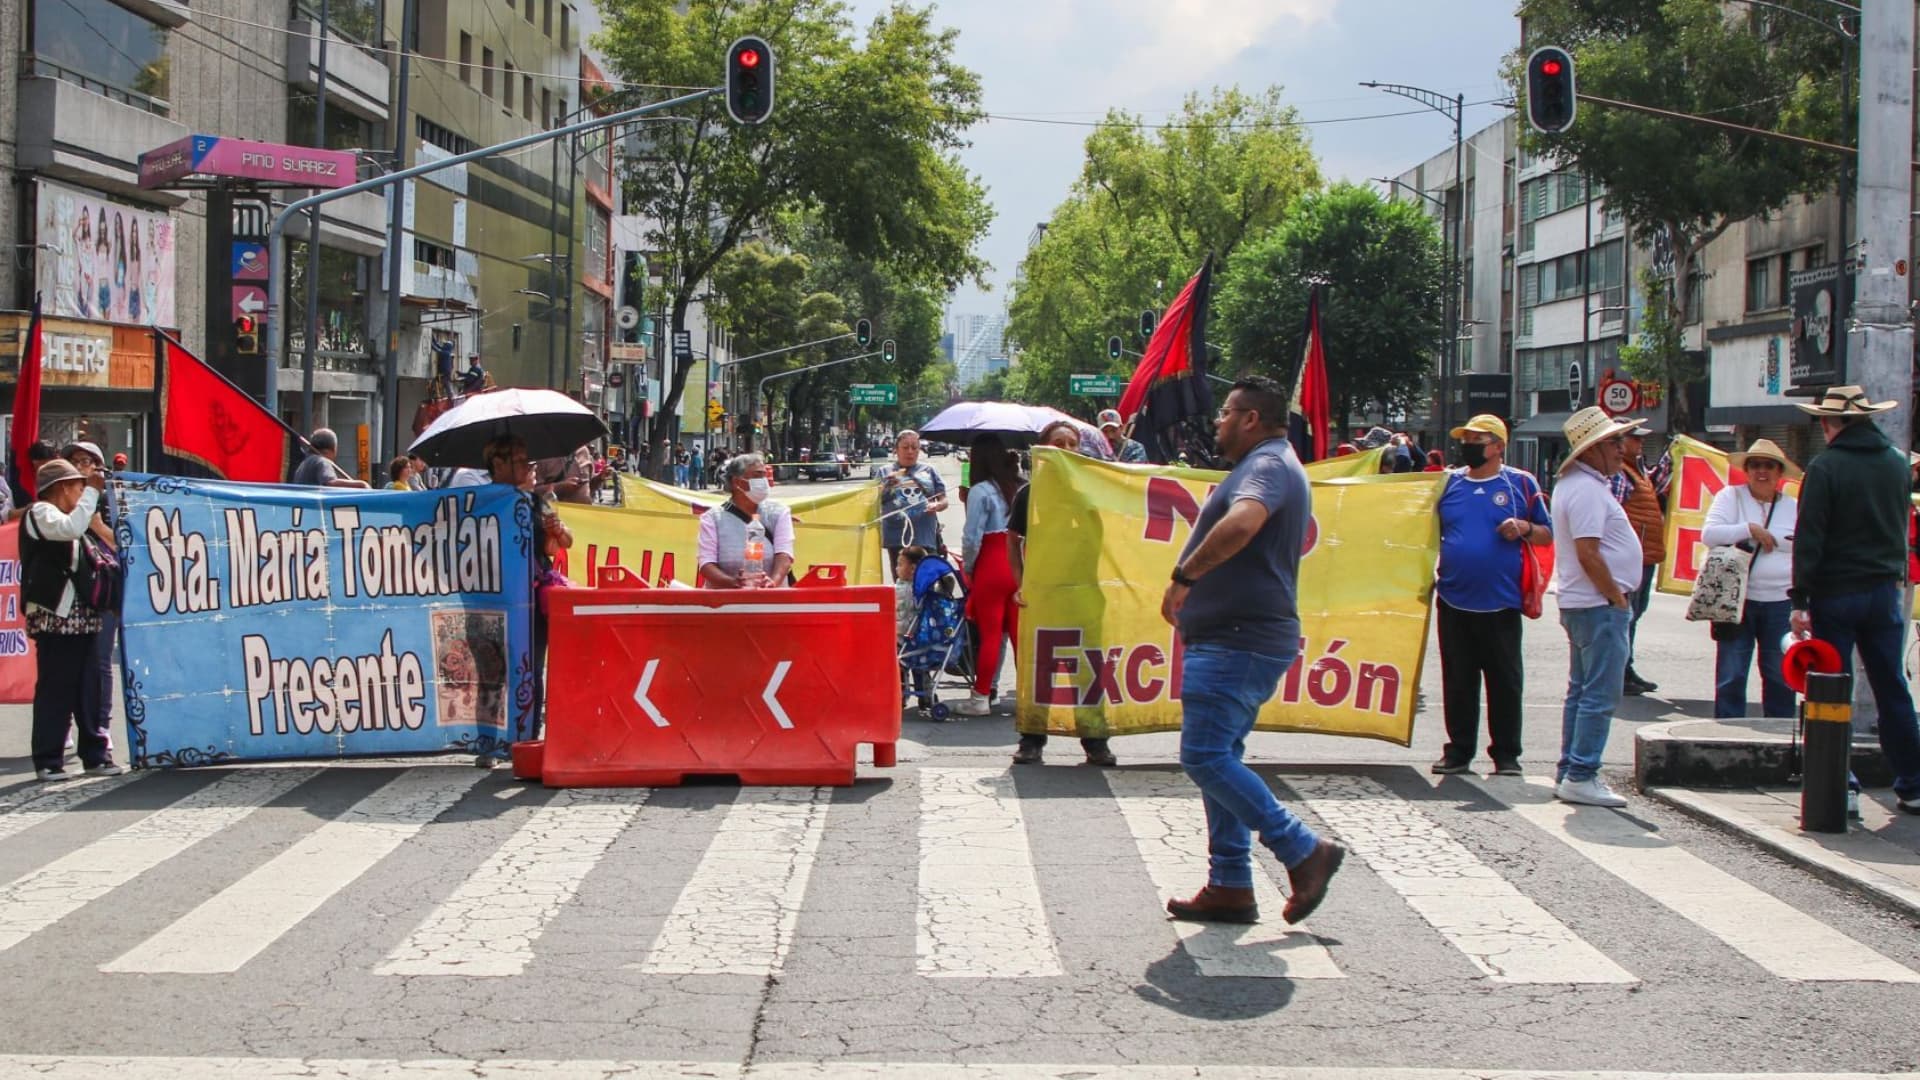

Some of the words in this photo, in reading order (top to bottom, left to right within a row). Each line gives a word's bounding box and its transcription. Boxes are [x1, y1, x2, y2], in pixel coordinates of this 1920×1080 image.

[197, 140, 206, 151] 2
[242, 152, 274, 168] PINO
[282, 157, 337, 176] SUAREZ
[1611, 387, 1627, 399] 50
[146, 506, 220, 614] Sta.
[224, 506, 329, 608] María
[332, 491, 502, 597] Tomatlán
[242, 628, 425, 735] Presente
[1034, 628, 1402, 715] Exclión
